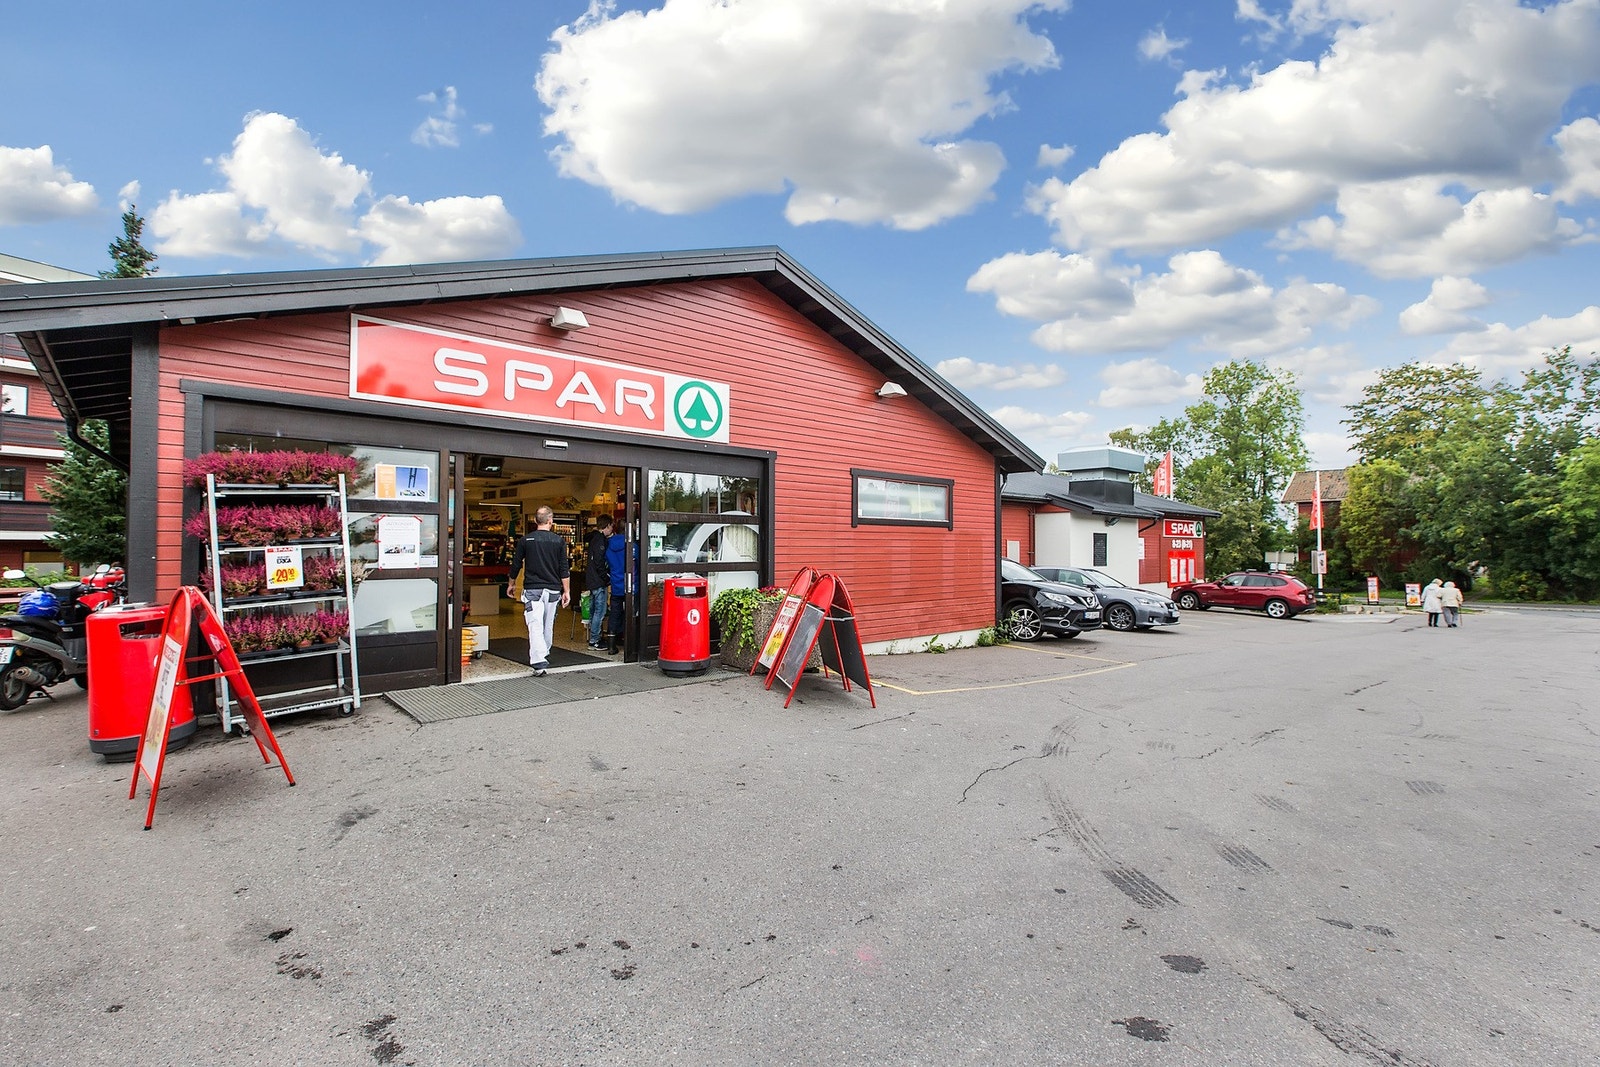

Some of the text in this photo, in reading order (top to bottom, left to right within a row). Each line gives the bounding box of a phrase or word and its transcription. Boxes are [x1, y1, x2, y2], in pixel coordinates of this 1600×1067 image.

[433, 347, 655, 420] SPAR
[1171, 522, 1194, 535] SPAR
[276, 569, 288, 582] 29
